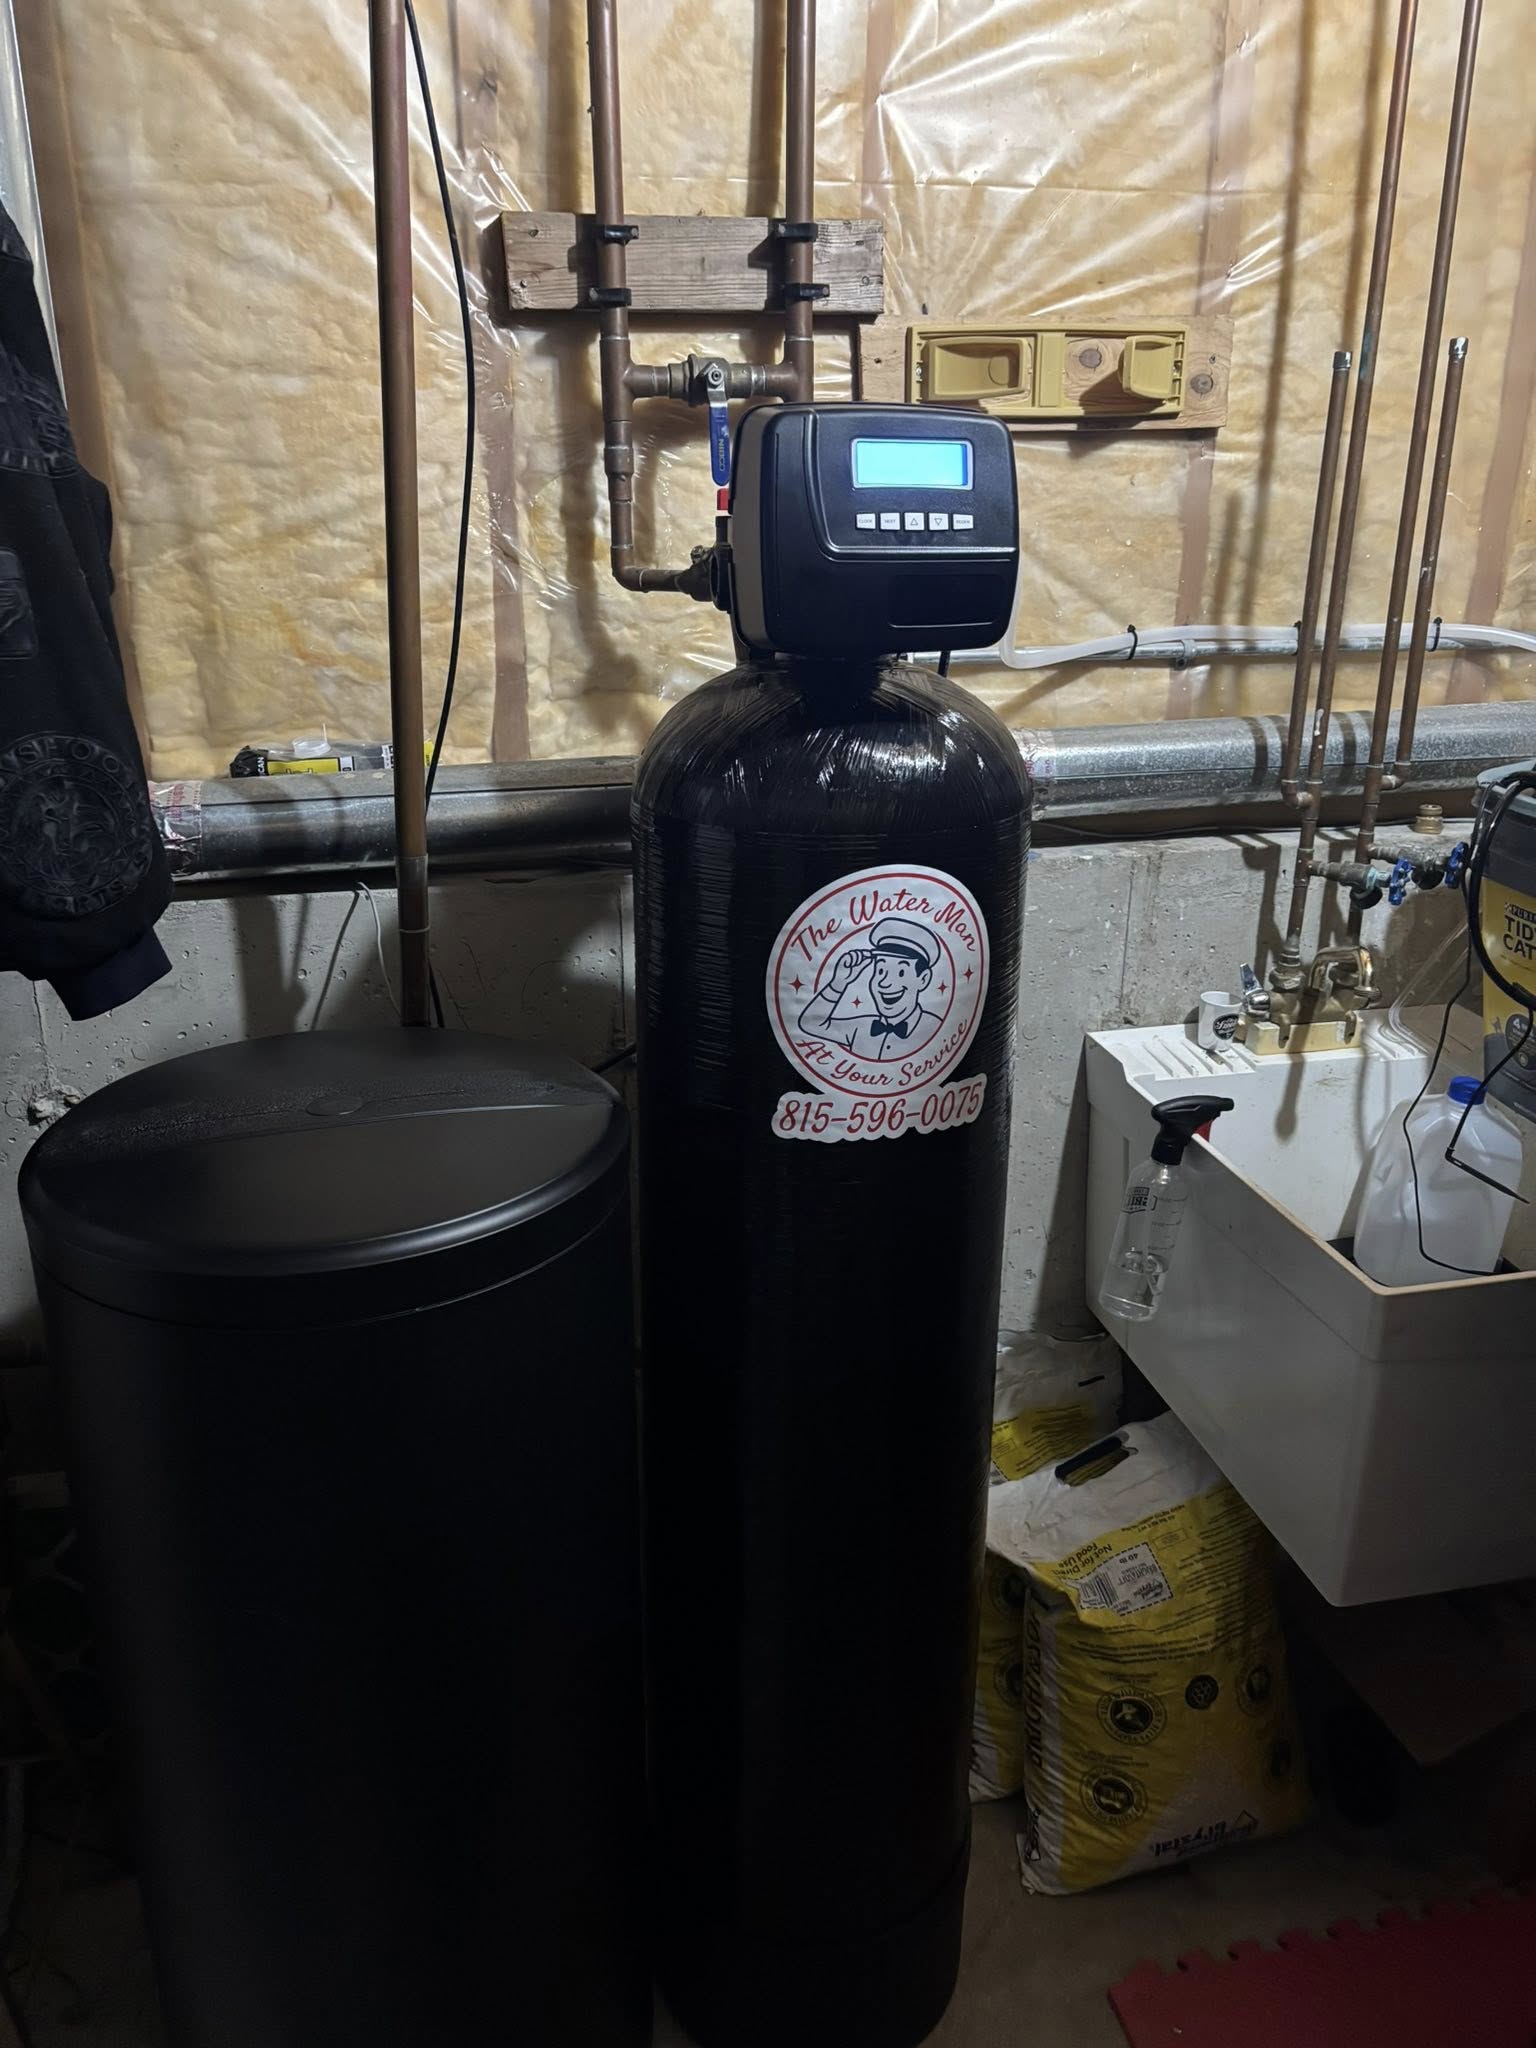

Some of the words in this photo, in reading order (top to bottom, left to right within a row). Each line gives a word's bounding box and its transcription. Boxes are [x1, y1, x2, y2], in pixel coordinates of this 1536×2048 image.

[791, 918, 842, 961] The
[850, 888, 934, 925] Water
[934, 902, 976, 951] Man
[1504, 915, 1536, 941] TID
[795, 1038, 836, 1065] At
[830, 1060, 893, 1086] Your
[898, 1018, 968, 1086] Service
[779, 1081, 983, 1135] 815-596-0075
